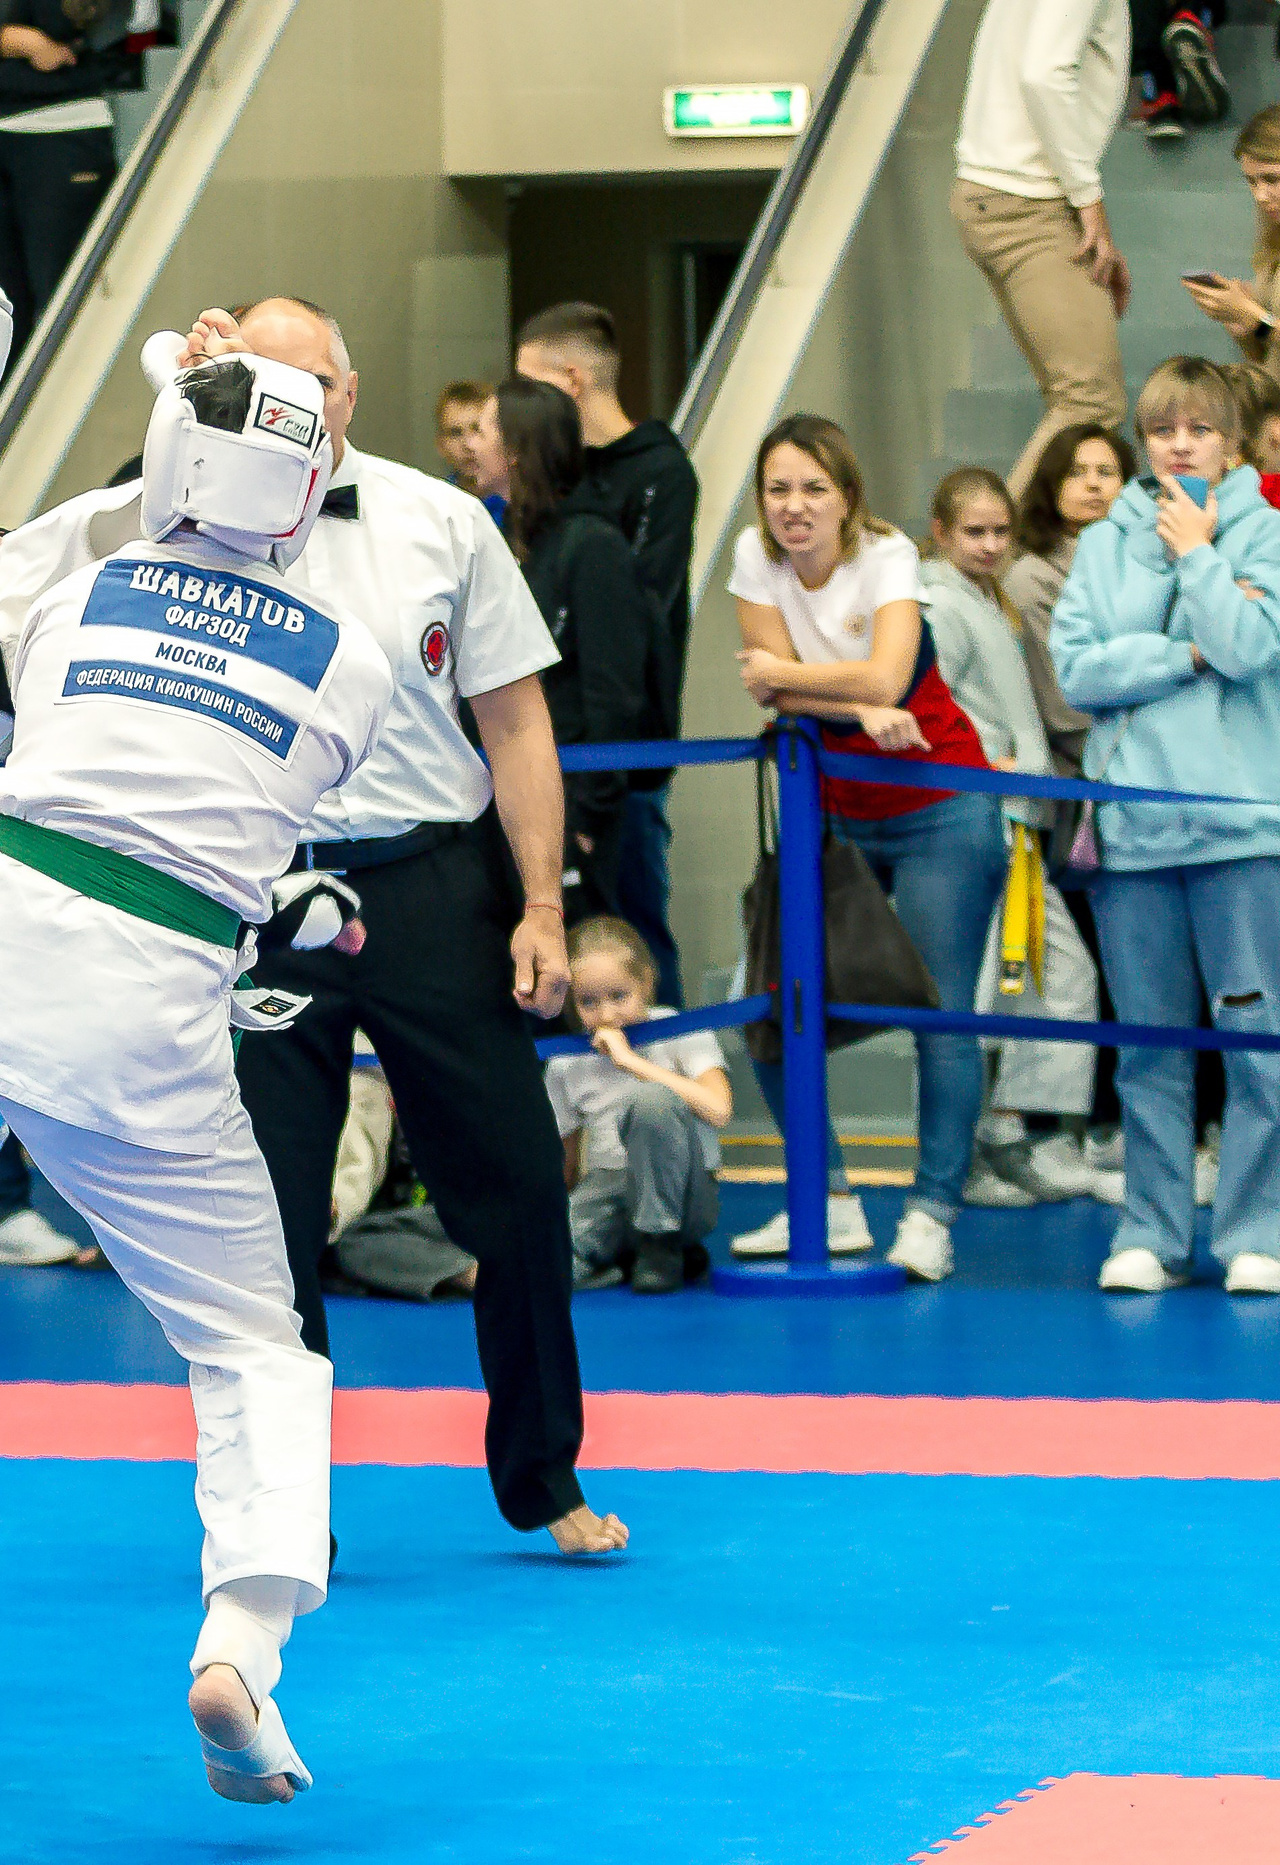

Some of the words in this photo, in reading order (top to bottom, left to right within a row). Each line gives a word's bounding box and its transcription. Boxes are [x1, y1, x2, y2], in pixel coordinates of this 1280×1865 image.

[129, 565, 306, 634] ШАВКАТОВ
[165, 605, 252, 648] ФАРЗОД
[154, 641, 228, 676] МОСКВА
[76, 668, 155, 692] ФЕДЕРАЦИЯ
[155, 676, 235, 715] КИОКУШИН
[234, 701, 284, 744] РОССИИ
